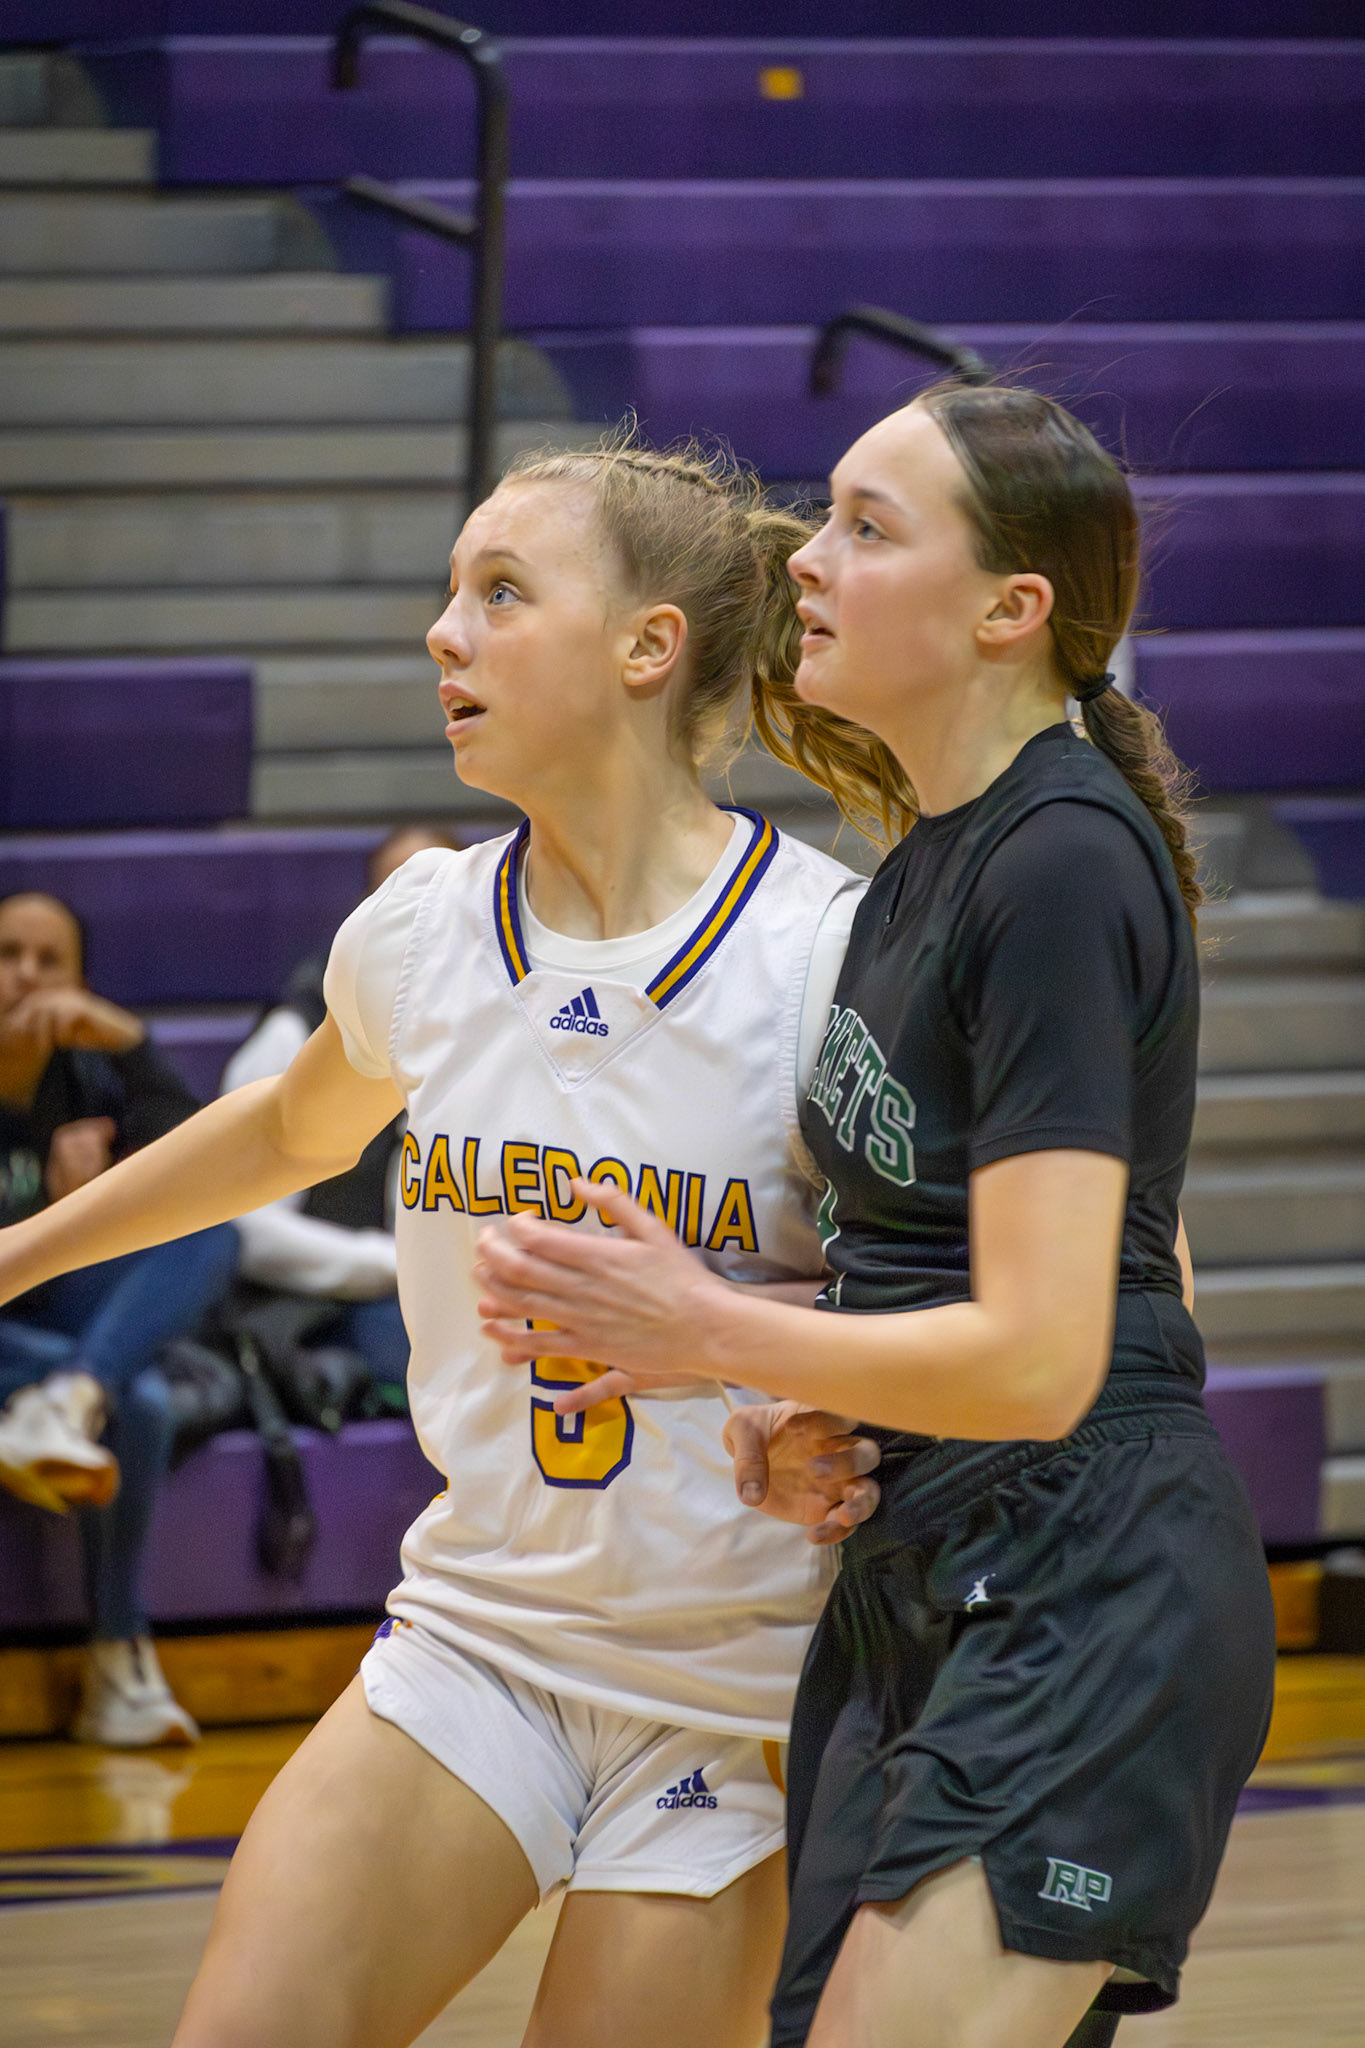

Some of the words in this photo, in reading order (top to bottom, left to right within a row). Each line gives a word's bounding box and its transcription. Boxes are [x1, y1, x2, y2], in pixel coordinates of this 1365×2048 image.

[549, 1013, 609, 1037] adidas
[807, 1003, 917, 1187] KETS
[400, 1129, 760, 1253] CALEDONIA
[656, 1793, 718, 1810] adidas
[1037, 1856, 1113, 1912] RP
